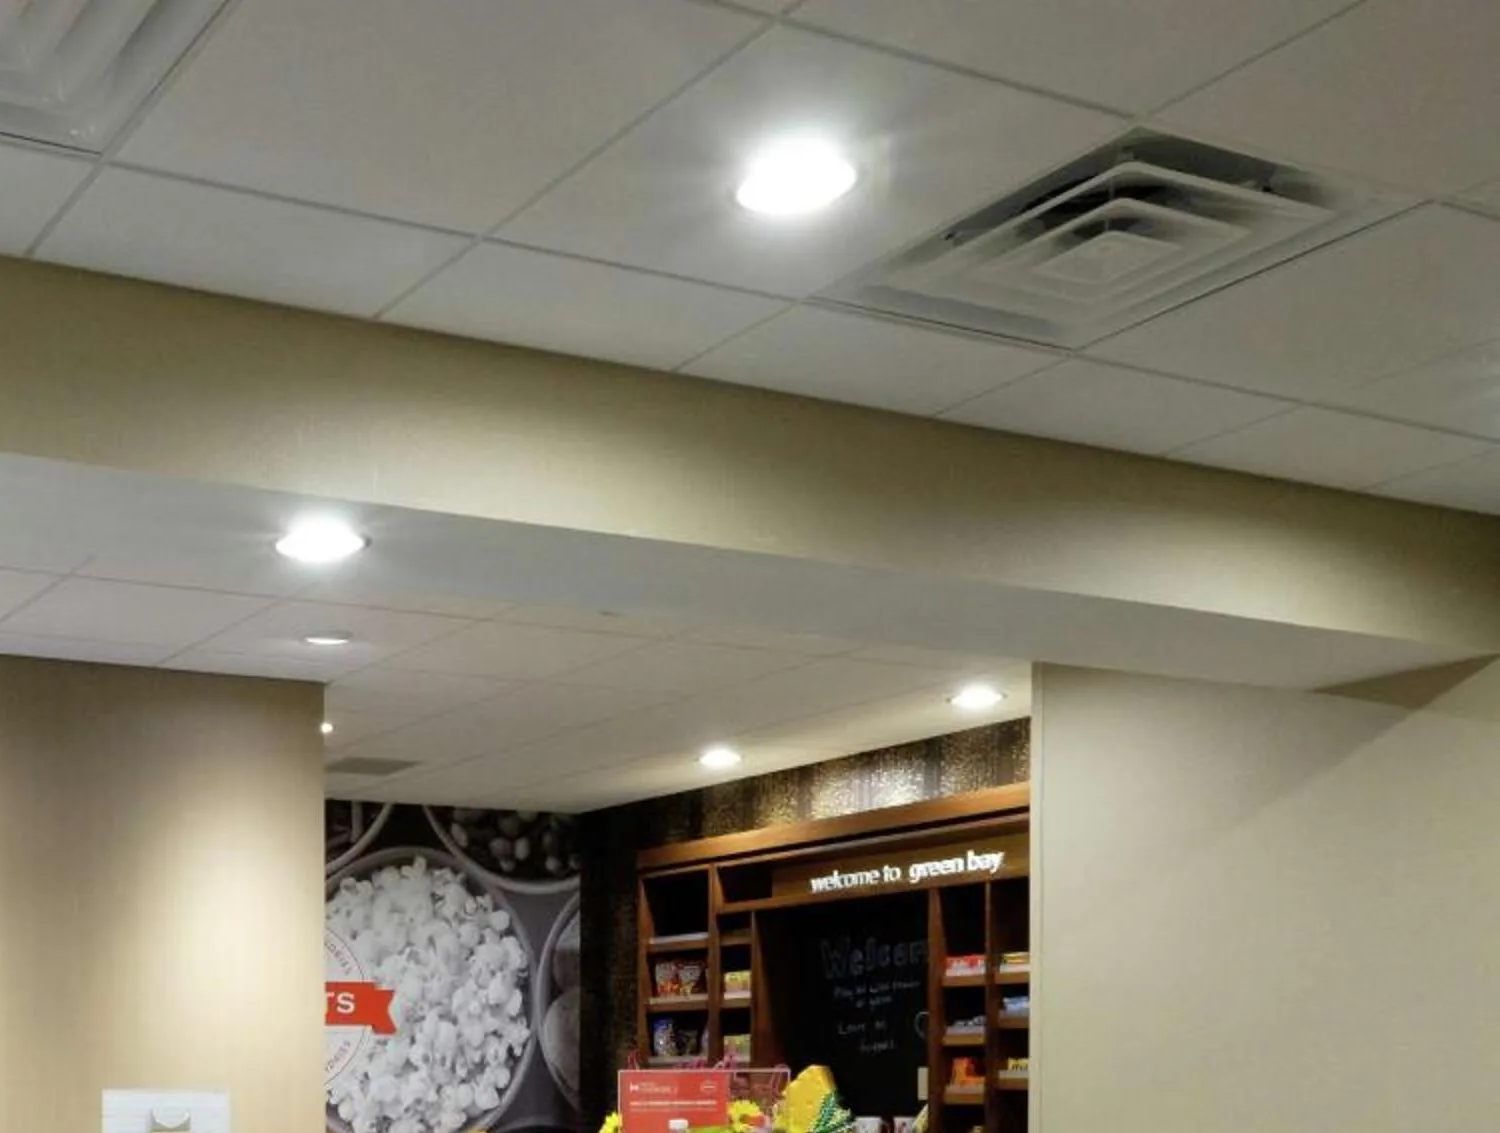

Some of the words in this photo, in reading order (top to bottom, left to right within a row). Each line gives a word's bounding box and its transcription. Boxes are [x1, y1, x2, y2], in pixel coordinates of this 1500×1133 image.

[810, 869, 880, 894] welcome
[882, 865, 901, 882] to
[909, 856, 964, 884] green
[967, 849, 1005, 874] bay
